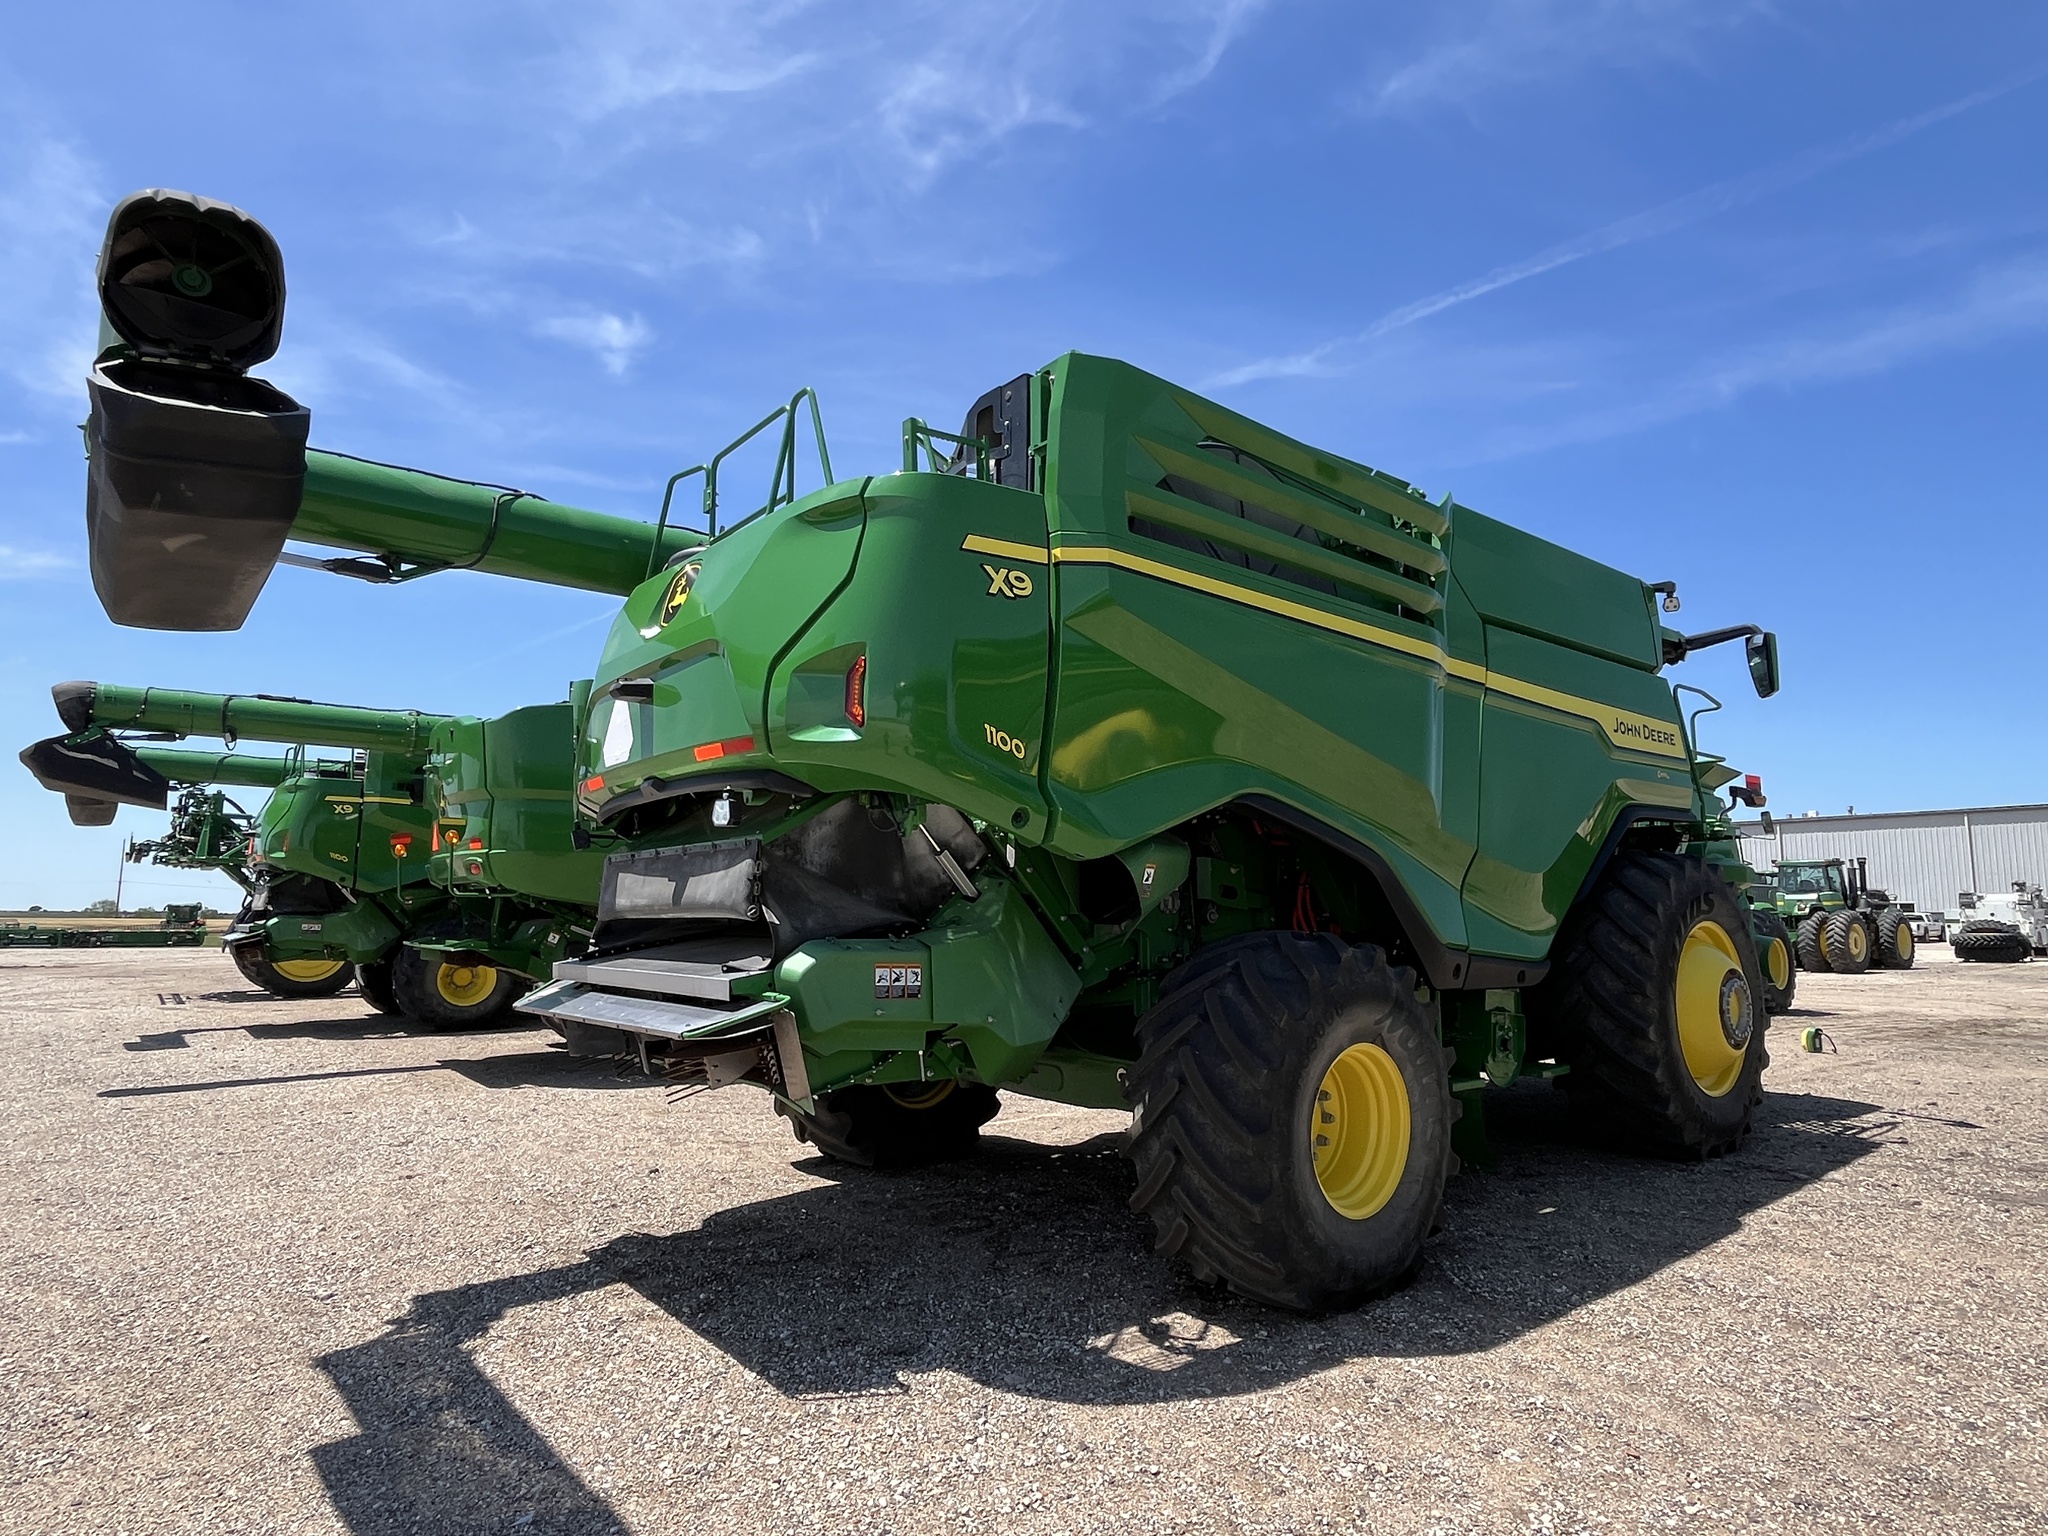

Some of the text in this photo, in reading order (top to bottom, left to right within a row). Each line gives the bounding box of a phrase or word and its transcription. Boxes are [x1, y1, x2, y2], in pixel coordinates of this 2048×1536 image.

[983, 564, 1033, 599] X9
[984, 722, 1026, 760] 1100
[1613, 717, 1676, 746] JOHN DEERE
[333, 804, 354, 814] X9
[329, 852, 349, 863] 1100
